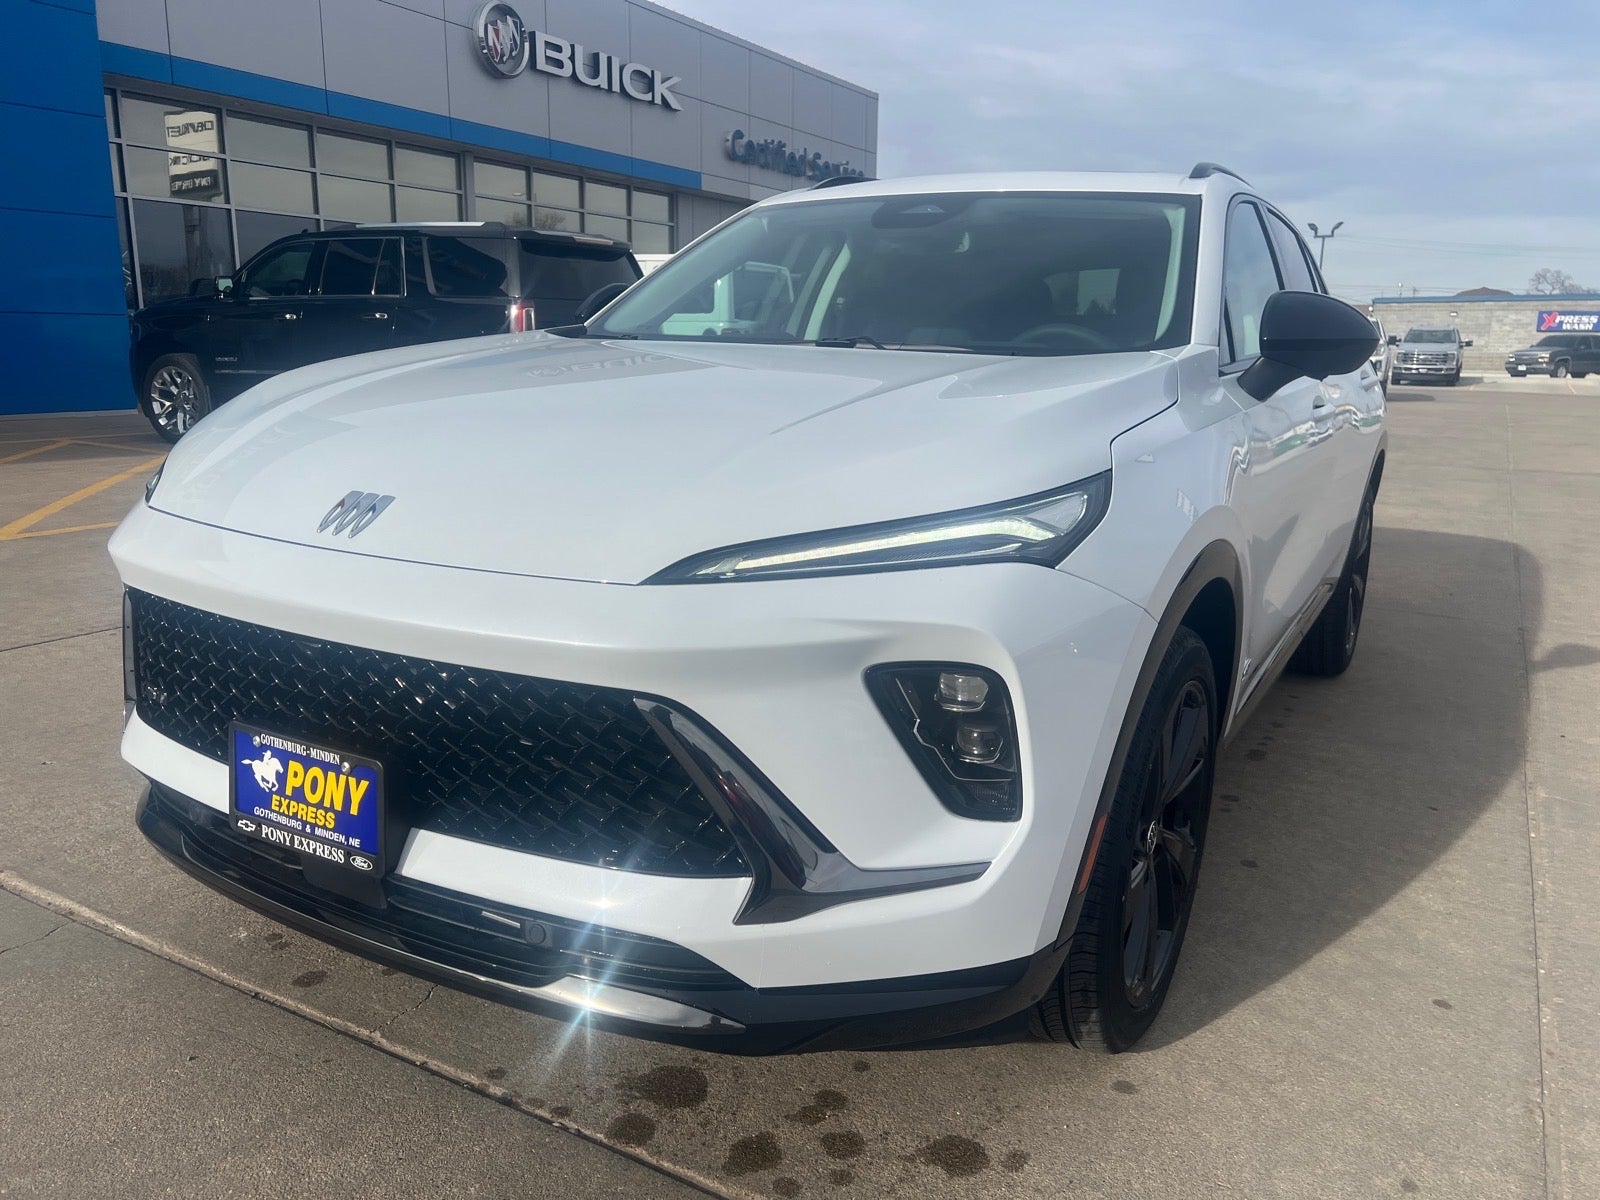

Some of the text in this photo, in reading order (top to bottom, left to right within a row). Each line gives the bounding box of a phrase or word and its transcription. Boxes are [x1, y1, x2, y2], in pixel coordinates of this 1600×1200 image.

[530, 31, 683, 111] BUICK
[730, 129, 807, 177] Certified
[1541, 312, 1599, 330] XPRESS
[1562, 322, 1594, 330] WASH
[285, 760, 370, 816] PONY
[253, 806, 361, 848] GOTHENBURG & MINDEN, NE
[271, 794, 336, 829] EXPRESS
[261, 824, 345, 864] PONY EXPRESS
